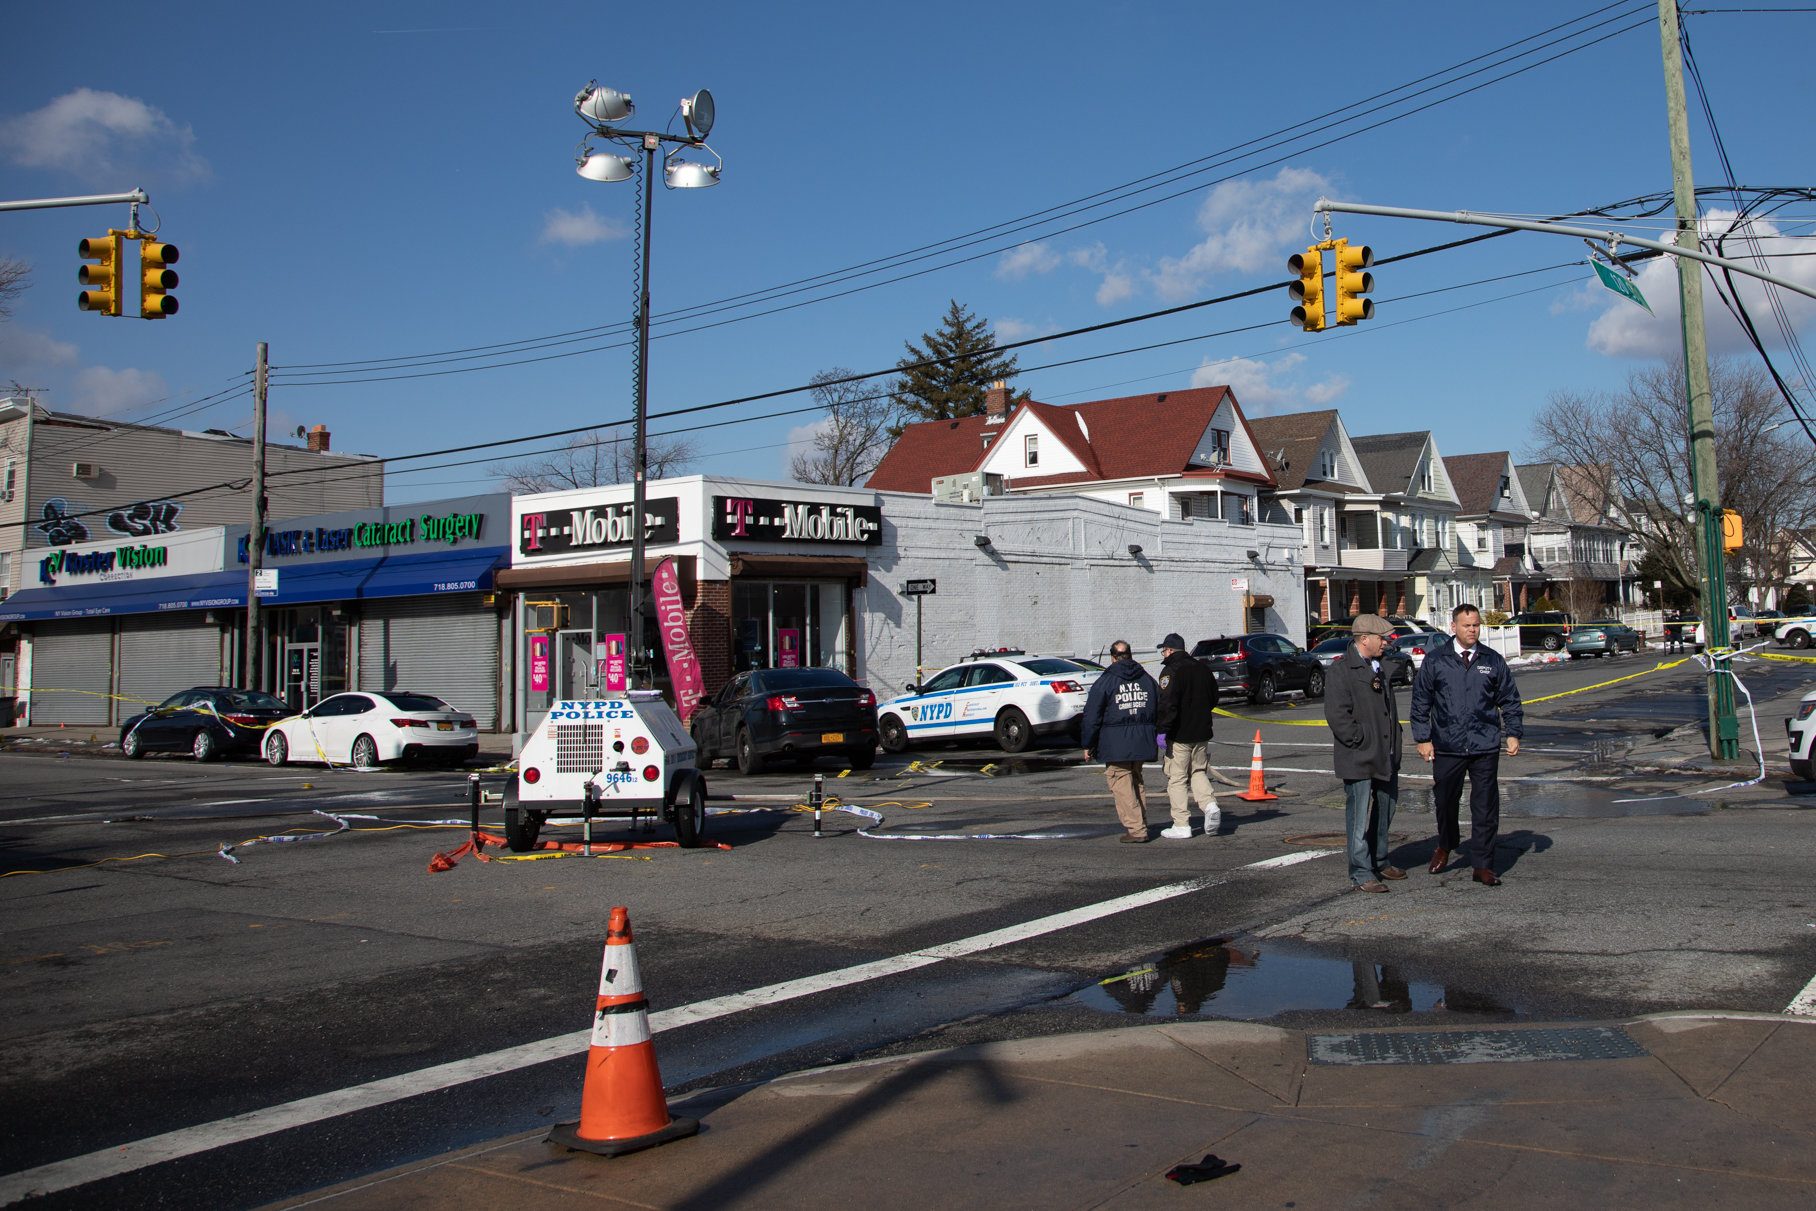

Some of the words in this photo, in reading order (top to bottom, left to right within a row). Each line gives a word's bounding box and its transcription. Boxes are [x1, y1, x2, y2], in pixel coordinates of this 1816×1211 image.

[354, 518, 415, 548] Cataract
[420, 513, 484, 545] Surgery
[116, 544, 168, 568] Vision
[433, 581, 476, 591] 718.805.0700
[660, 581, 695, 664] Mobile
[1119, 682, 1142, 693] N.Y.C.
[1115, 692, 1148, 704] POLICE
[560, 701, 624, 710] NYPD
[550, 710, 634, 720] POLICE
[920, 702, 953, 722] NYPD
[606, 772, 632, 783] 9646
